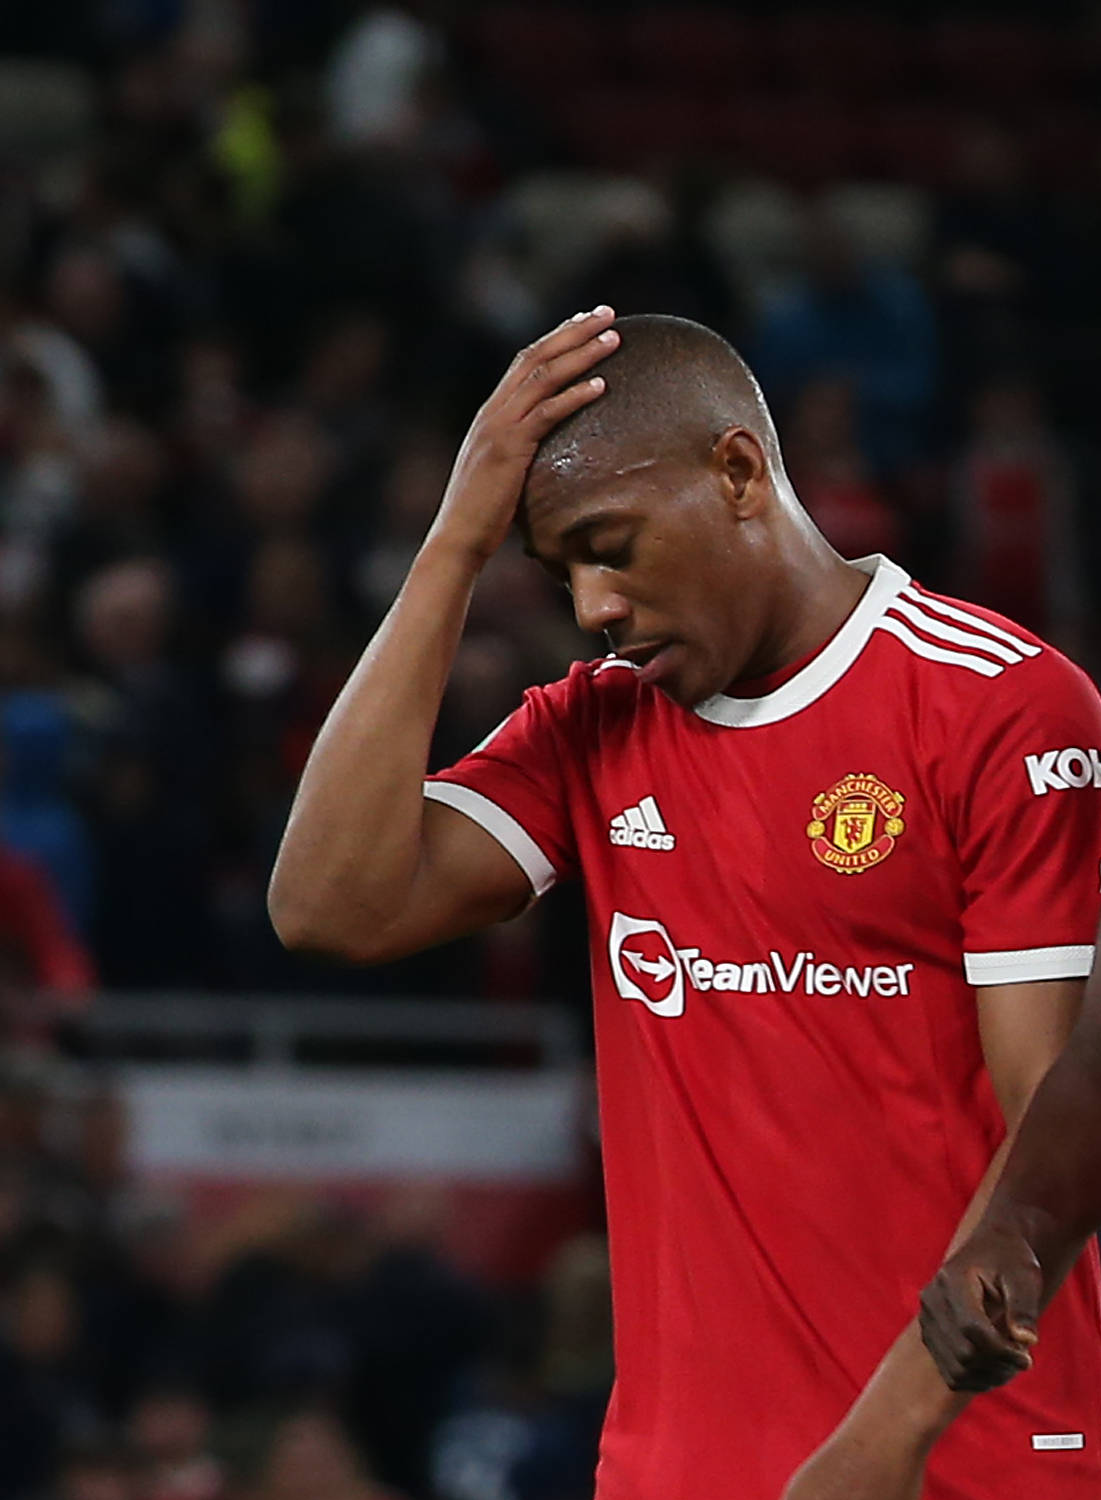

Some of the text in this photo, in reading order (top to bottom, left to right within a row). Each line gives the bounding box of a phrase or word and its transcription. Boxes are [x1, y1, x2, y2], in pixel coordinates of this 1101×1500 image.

[819, 781, 896, 814] MANCHESTER
[824, 848, 880, 866] UNITED
[676, 948, 914, 997] TeamViewer
